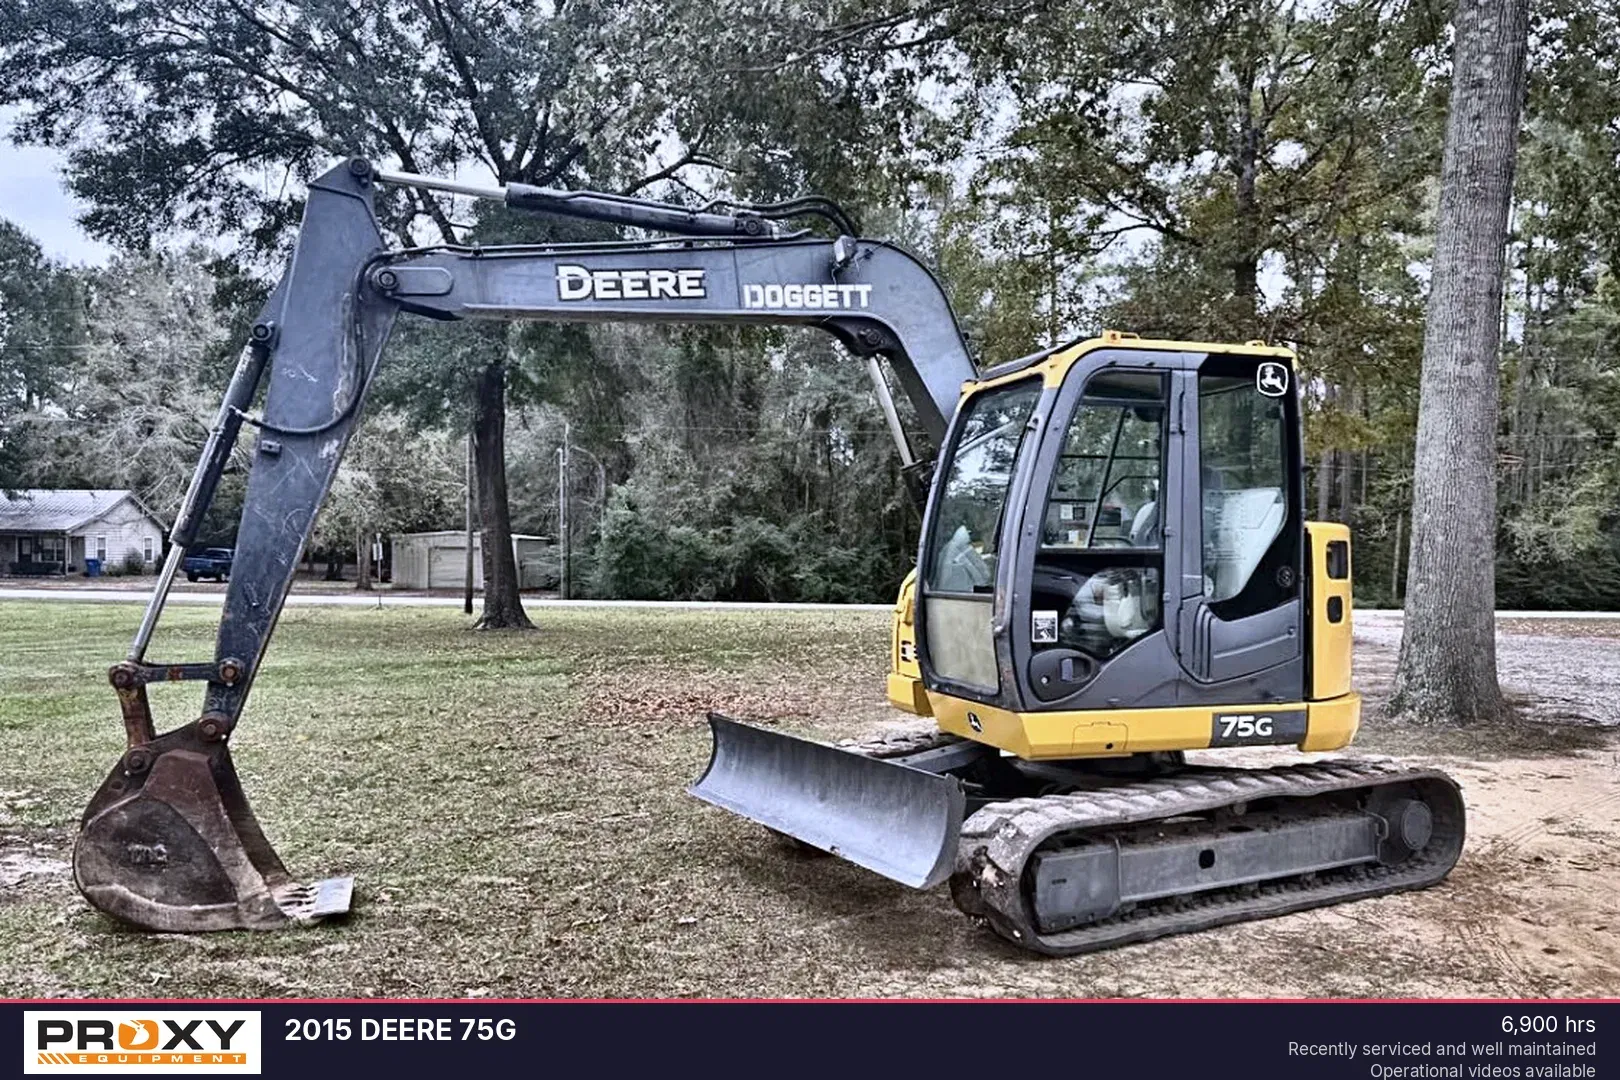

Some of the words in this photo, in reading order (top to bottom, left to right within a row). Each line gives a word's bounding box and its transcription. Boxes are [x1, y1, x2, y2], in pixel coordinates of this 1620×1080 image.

[556, 263, 707, 302] DEERE
[743, 283, 873, 309] DOGGETT
[1220, 715, 1273, 738] 75G
